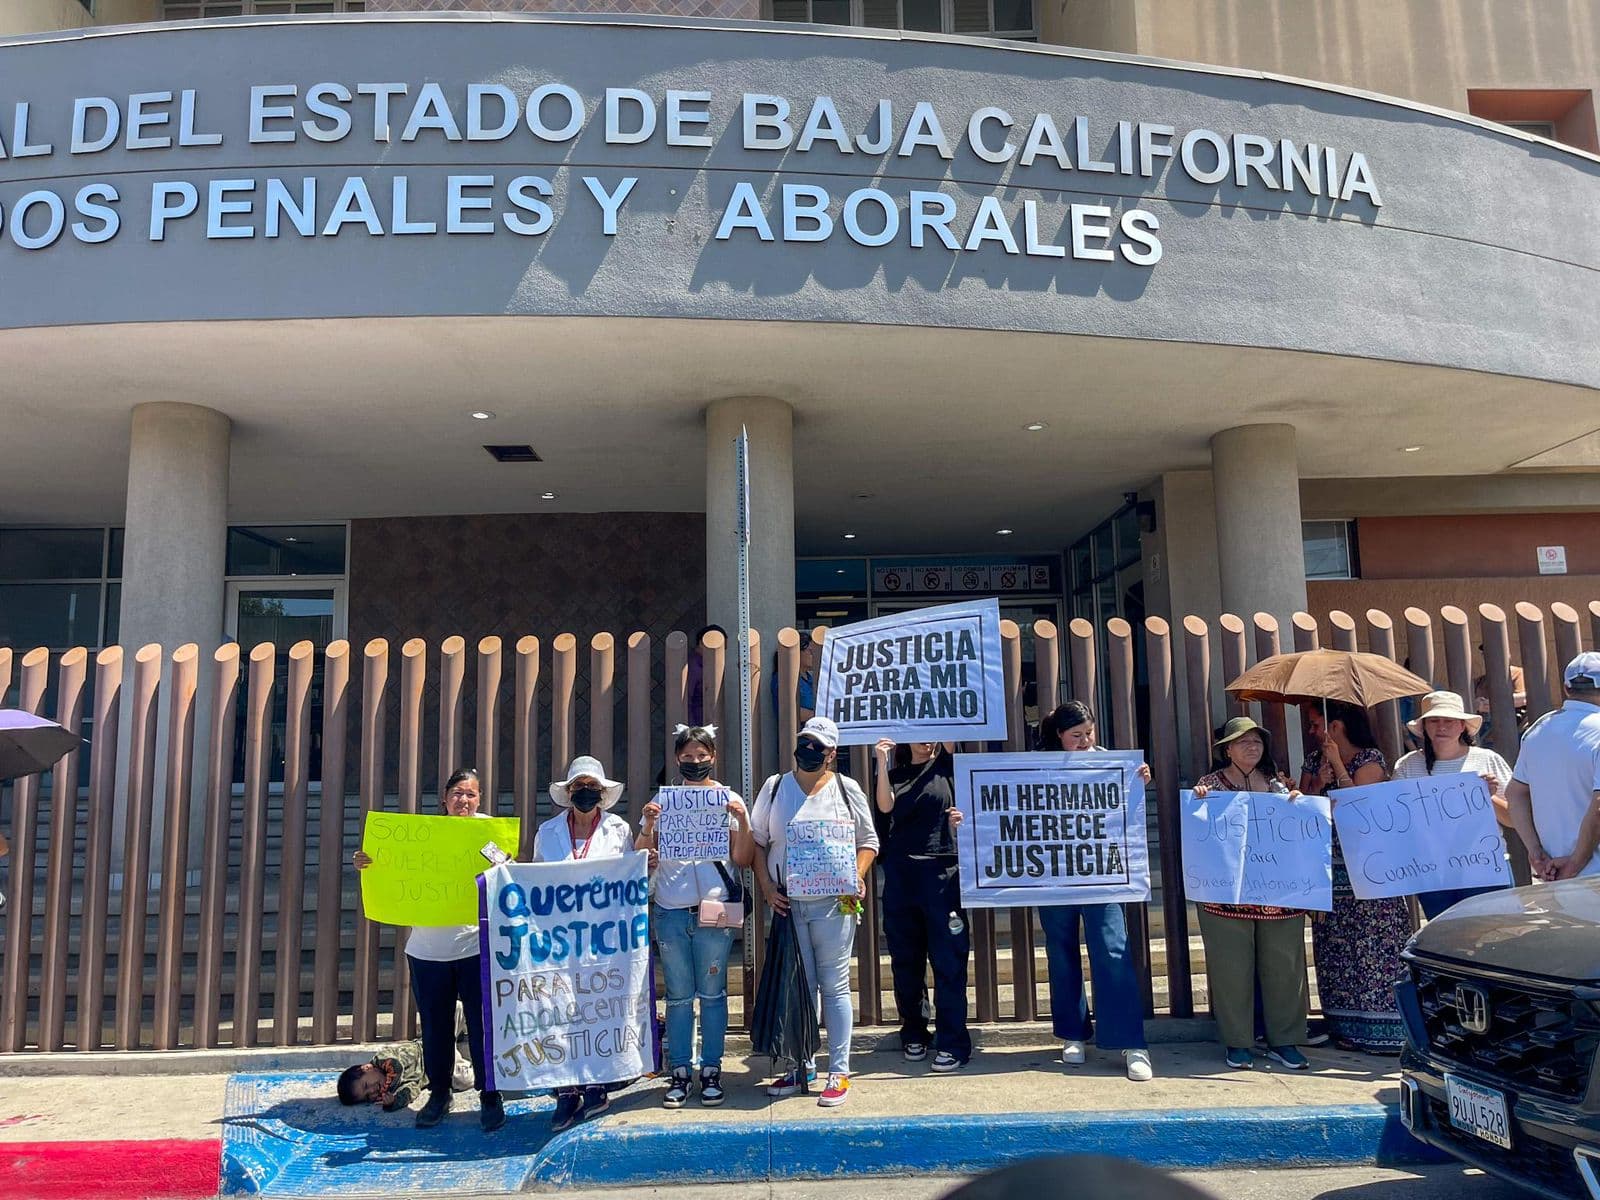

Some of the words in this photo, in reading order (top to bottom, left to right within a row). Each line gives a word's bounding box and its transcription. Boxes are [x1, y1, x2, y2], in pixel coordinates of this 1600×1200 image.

[0, 102, 52, 159] L
[70, 89, 223, 154] DEL
[249, 82, 585, 144] ESTADO
[605, 86, 713, 149] DE
[742, 93, 952, 160] BAJA
[967, 107, 1382, 208] CALIFORNIA
[0, 183, 120, 250] OS
[150, 174, 556, 242] PENALES
[583, 176, 638, 236] Y
[716, 182, 1163, 267] ABORALES
[837, 629, 977, 674] JUSTICIA
[845, 666, 921, 696] PARA
[930, 663, 968, 690] MI
[834, 689, 978, 723] HERMANO
[661, 789, 730, 812] JUSTICIA
[980, 785, 1010, 811] MI
[1016, 782, 1121, 811] HERMANO
[370, 817, 431, 843] SOLO
[660, 813, 696, 830] PARA
[699, 812, 718, 826] LOS
[720, 813, 729, 827] 2
[787, 824, 855, 842] JUSTICIA
[1000, 813, 1107, 842] MERECE
[984, 842, 1124, 878] JUSTICIA
[1363, 850, 1437, 885] Cuantos
[1448, 834, 1502, 873] mas?
[499, 876, 649, 917] Queremos
[495, 913, 649, 970] JUSTICIA
[496, 972, 572, 1007] PARA
[576, 967, 625, 994] LOS
[1452, 1095, 1505, 1137] 9UJL528
